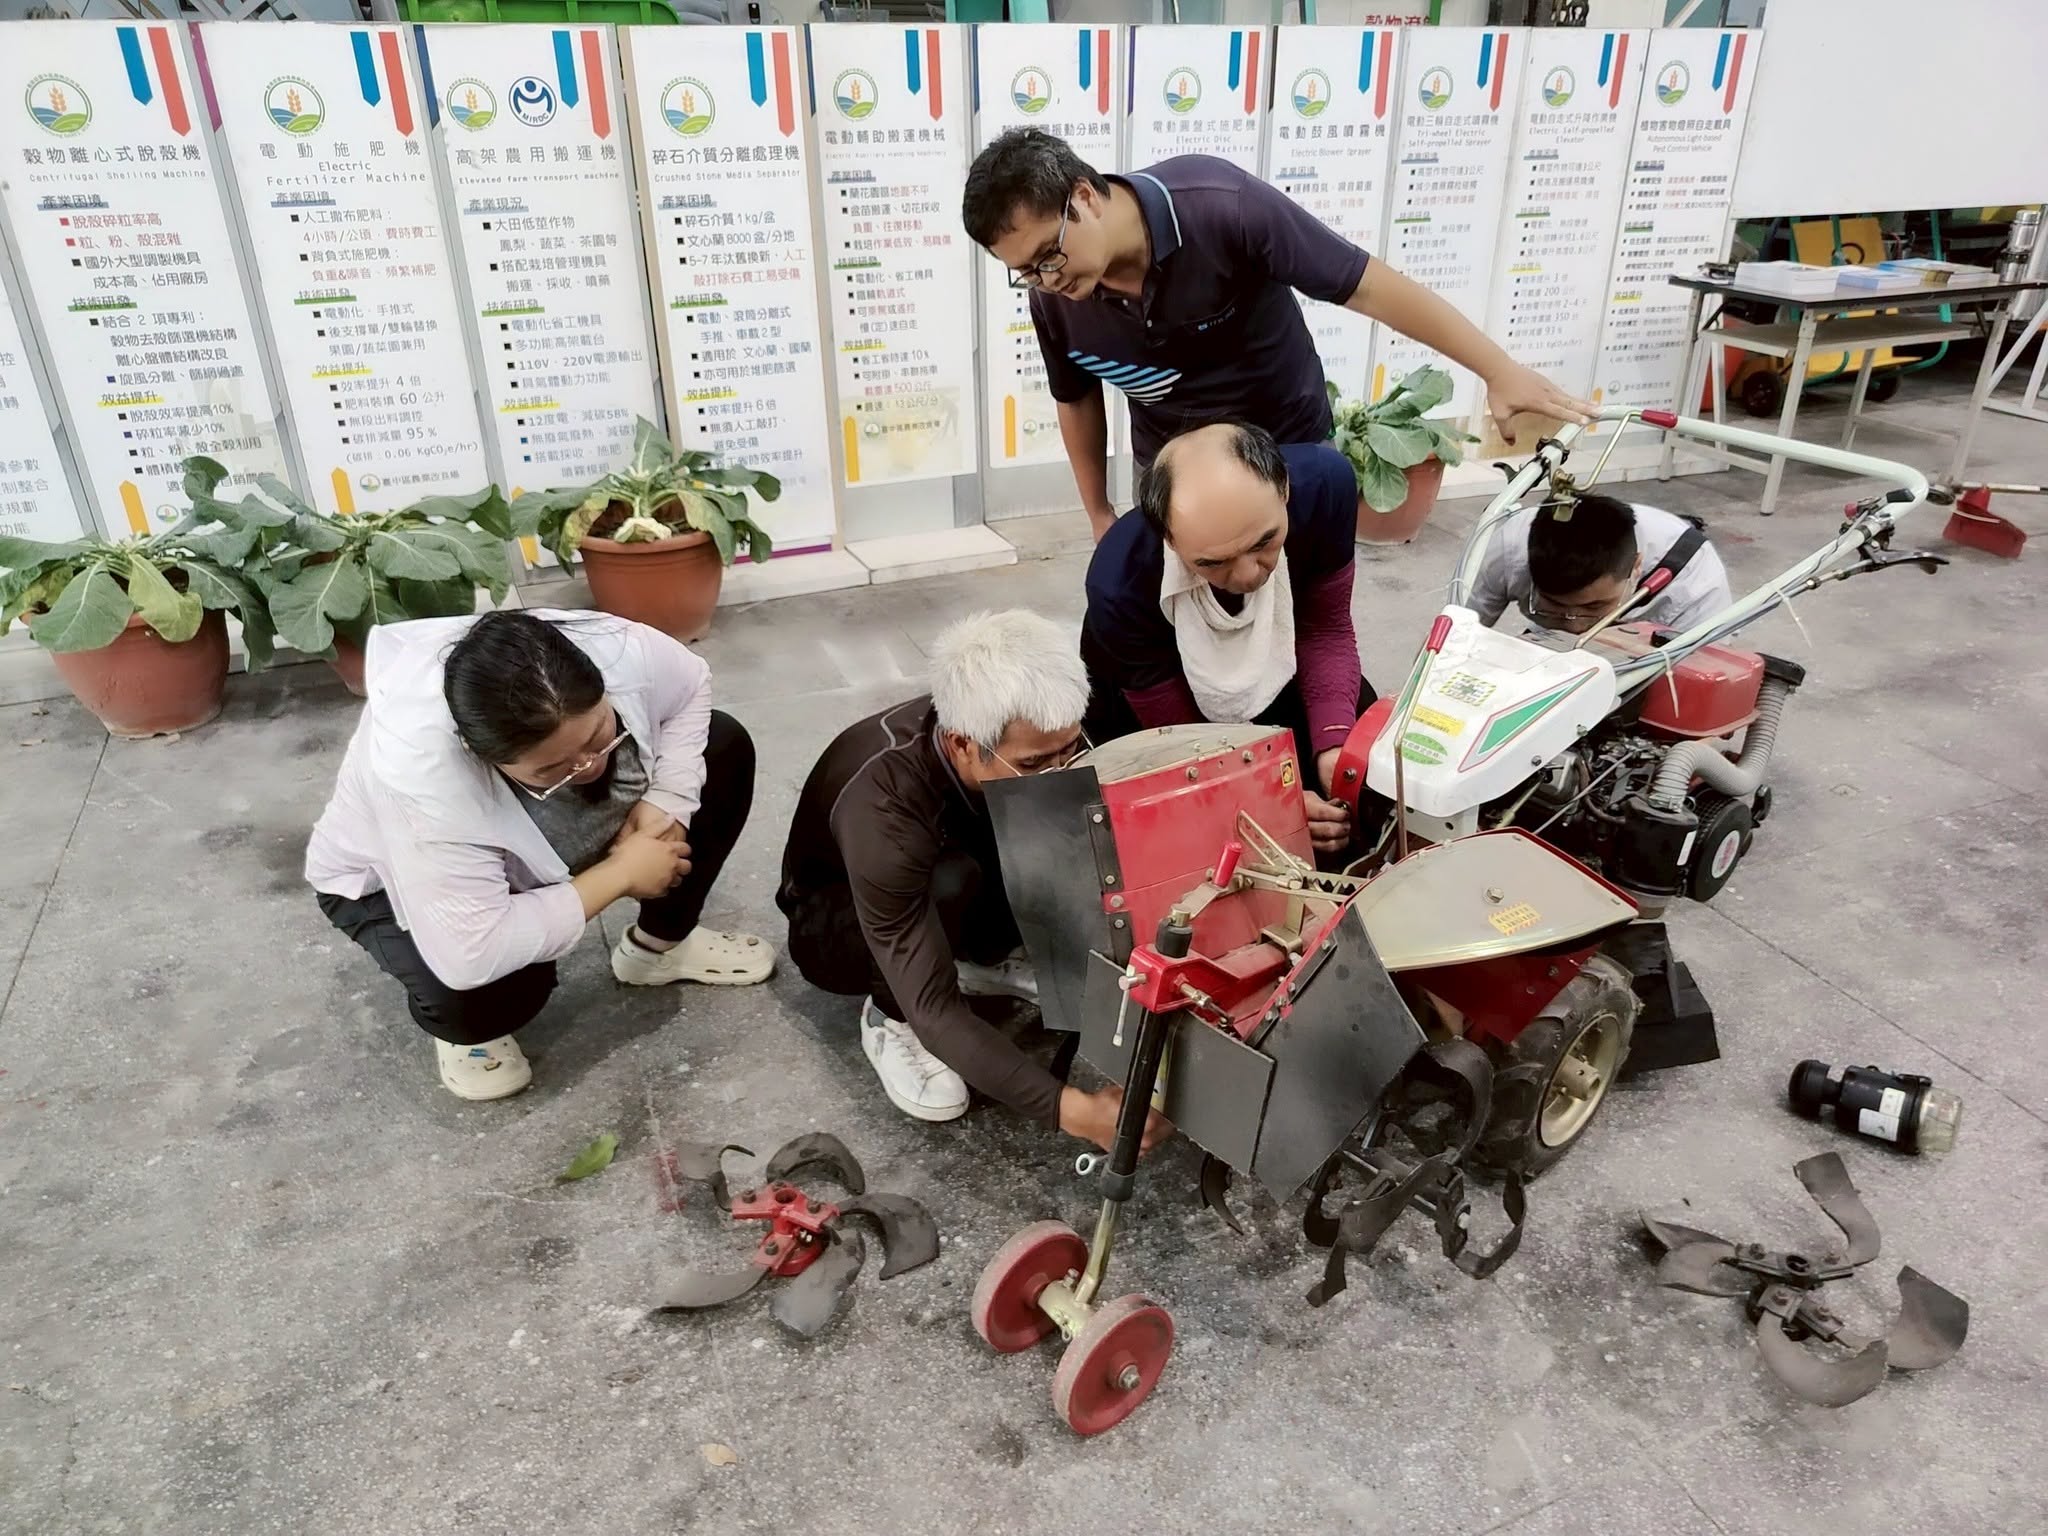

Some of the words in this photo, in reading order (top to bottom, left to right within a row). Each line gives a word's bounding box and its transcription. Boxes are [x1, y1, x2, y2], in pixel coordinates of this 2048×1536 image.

[22, 144, 201, 165] 穀物離心式脫殼機
[260, 140, 421, 159] 電動施肥機
[456, 145, 617, 165] 高架農用搬運機
[652, 145, 800, 165] 碎石介質分離處理機
[318, 161, 371, 171] Electric
[163, 170, 206, 178] Machine
[267, 175, 355, 186] Fertilizer
[366, 173, 426, 183] Machine
[459, 175, 501, 185] Elevated
[655, 173, 691, 183] Crushed
[697, 172, 722, 181] Stone
[396, 376, 404, 387] 4
[399, 392, 417, 405] 60
[406, 427, 424, 440] 95
[0, 478, 49, 494] 制整合
